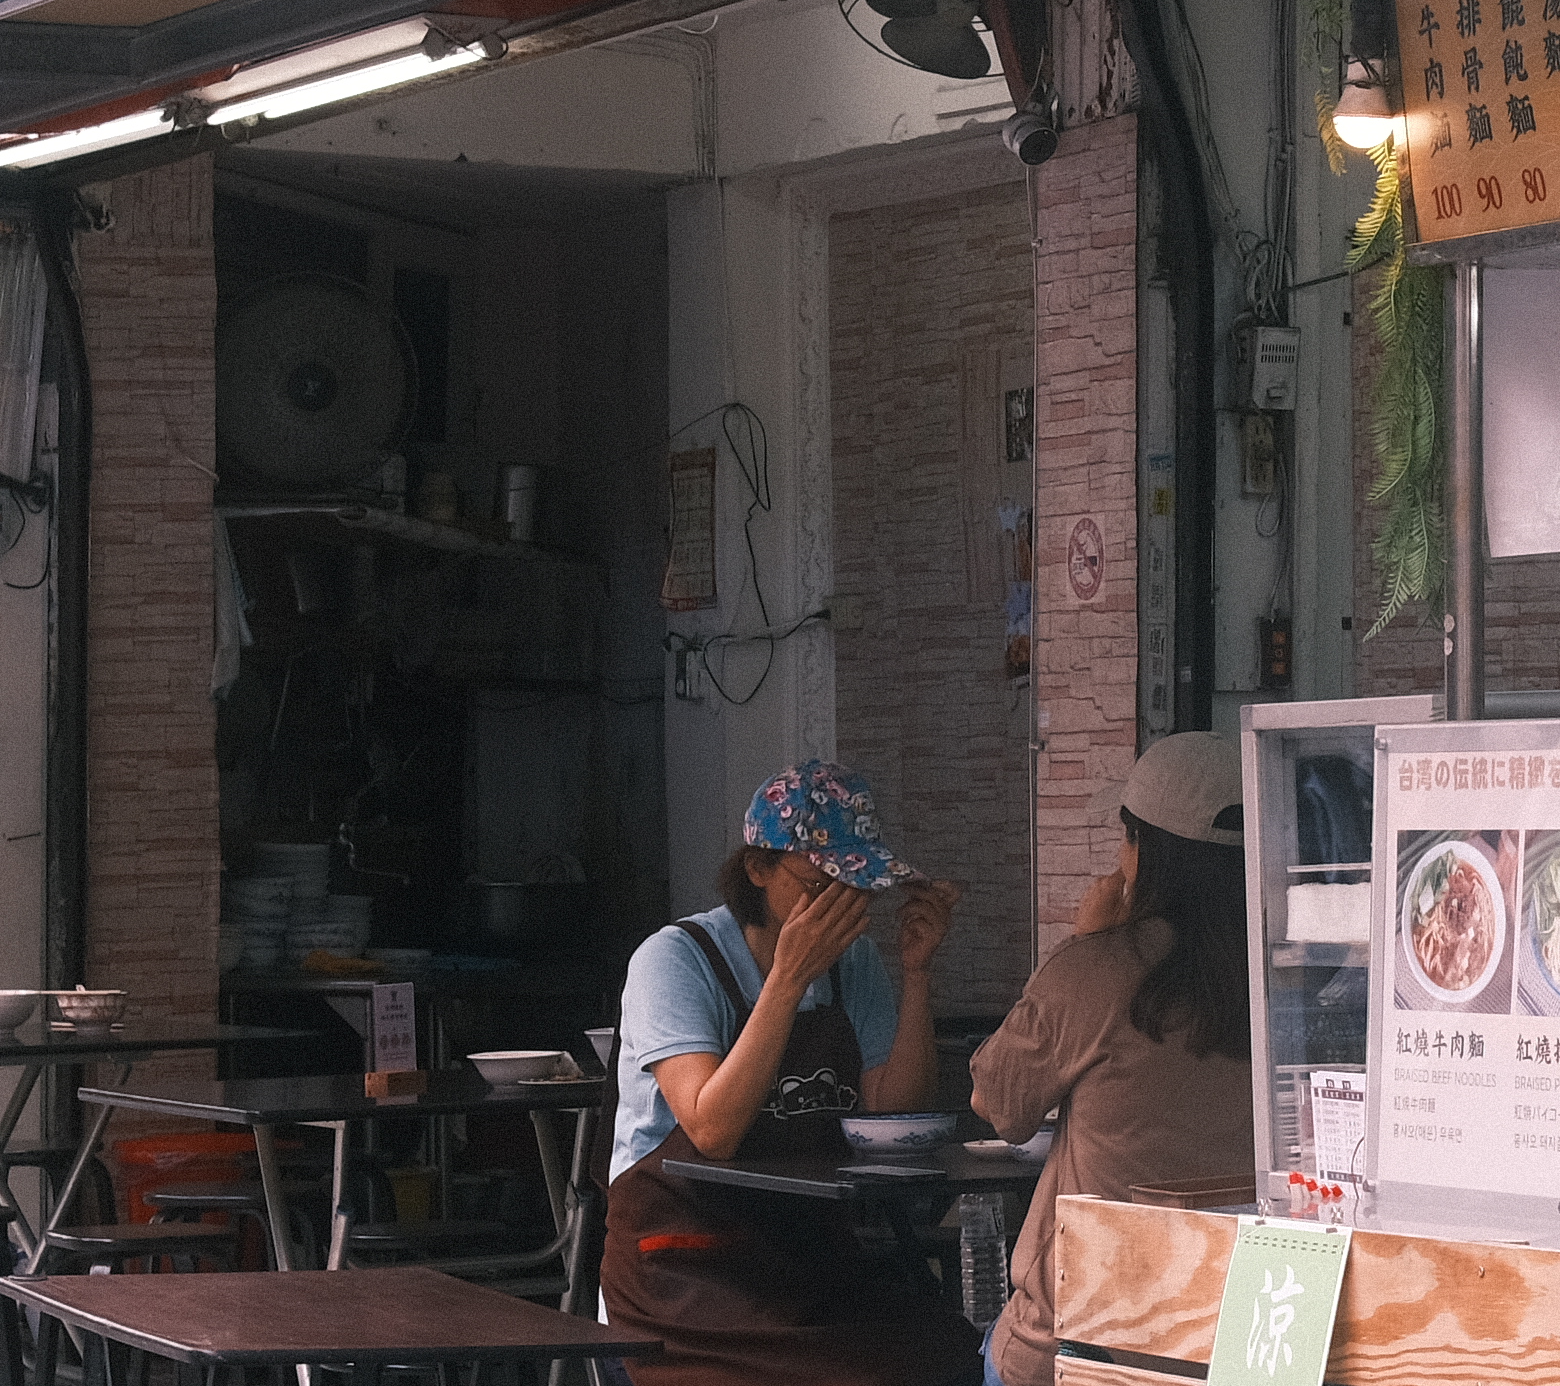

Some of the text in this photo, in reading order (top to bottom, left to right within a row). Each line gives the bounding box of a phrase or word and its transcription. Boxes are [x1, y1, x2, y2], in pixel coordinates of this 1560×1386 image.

[1431, 183, 1463, 220] 100
[1477, 175, 1503, 212] 90
[1522, 167, 1547, 204] 80
[1396, 1027, 1485, 1061] 紅燒牛肉麵
[1394, 1068, 1497, 1088] BRAISED BEEF NOODLES
[1515, 1076, 1552, 1092] BRAISED
